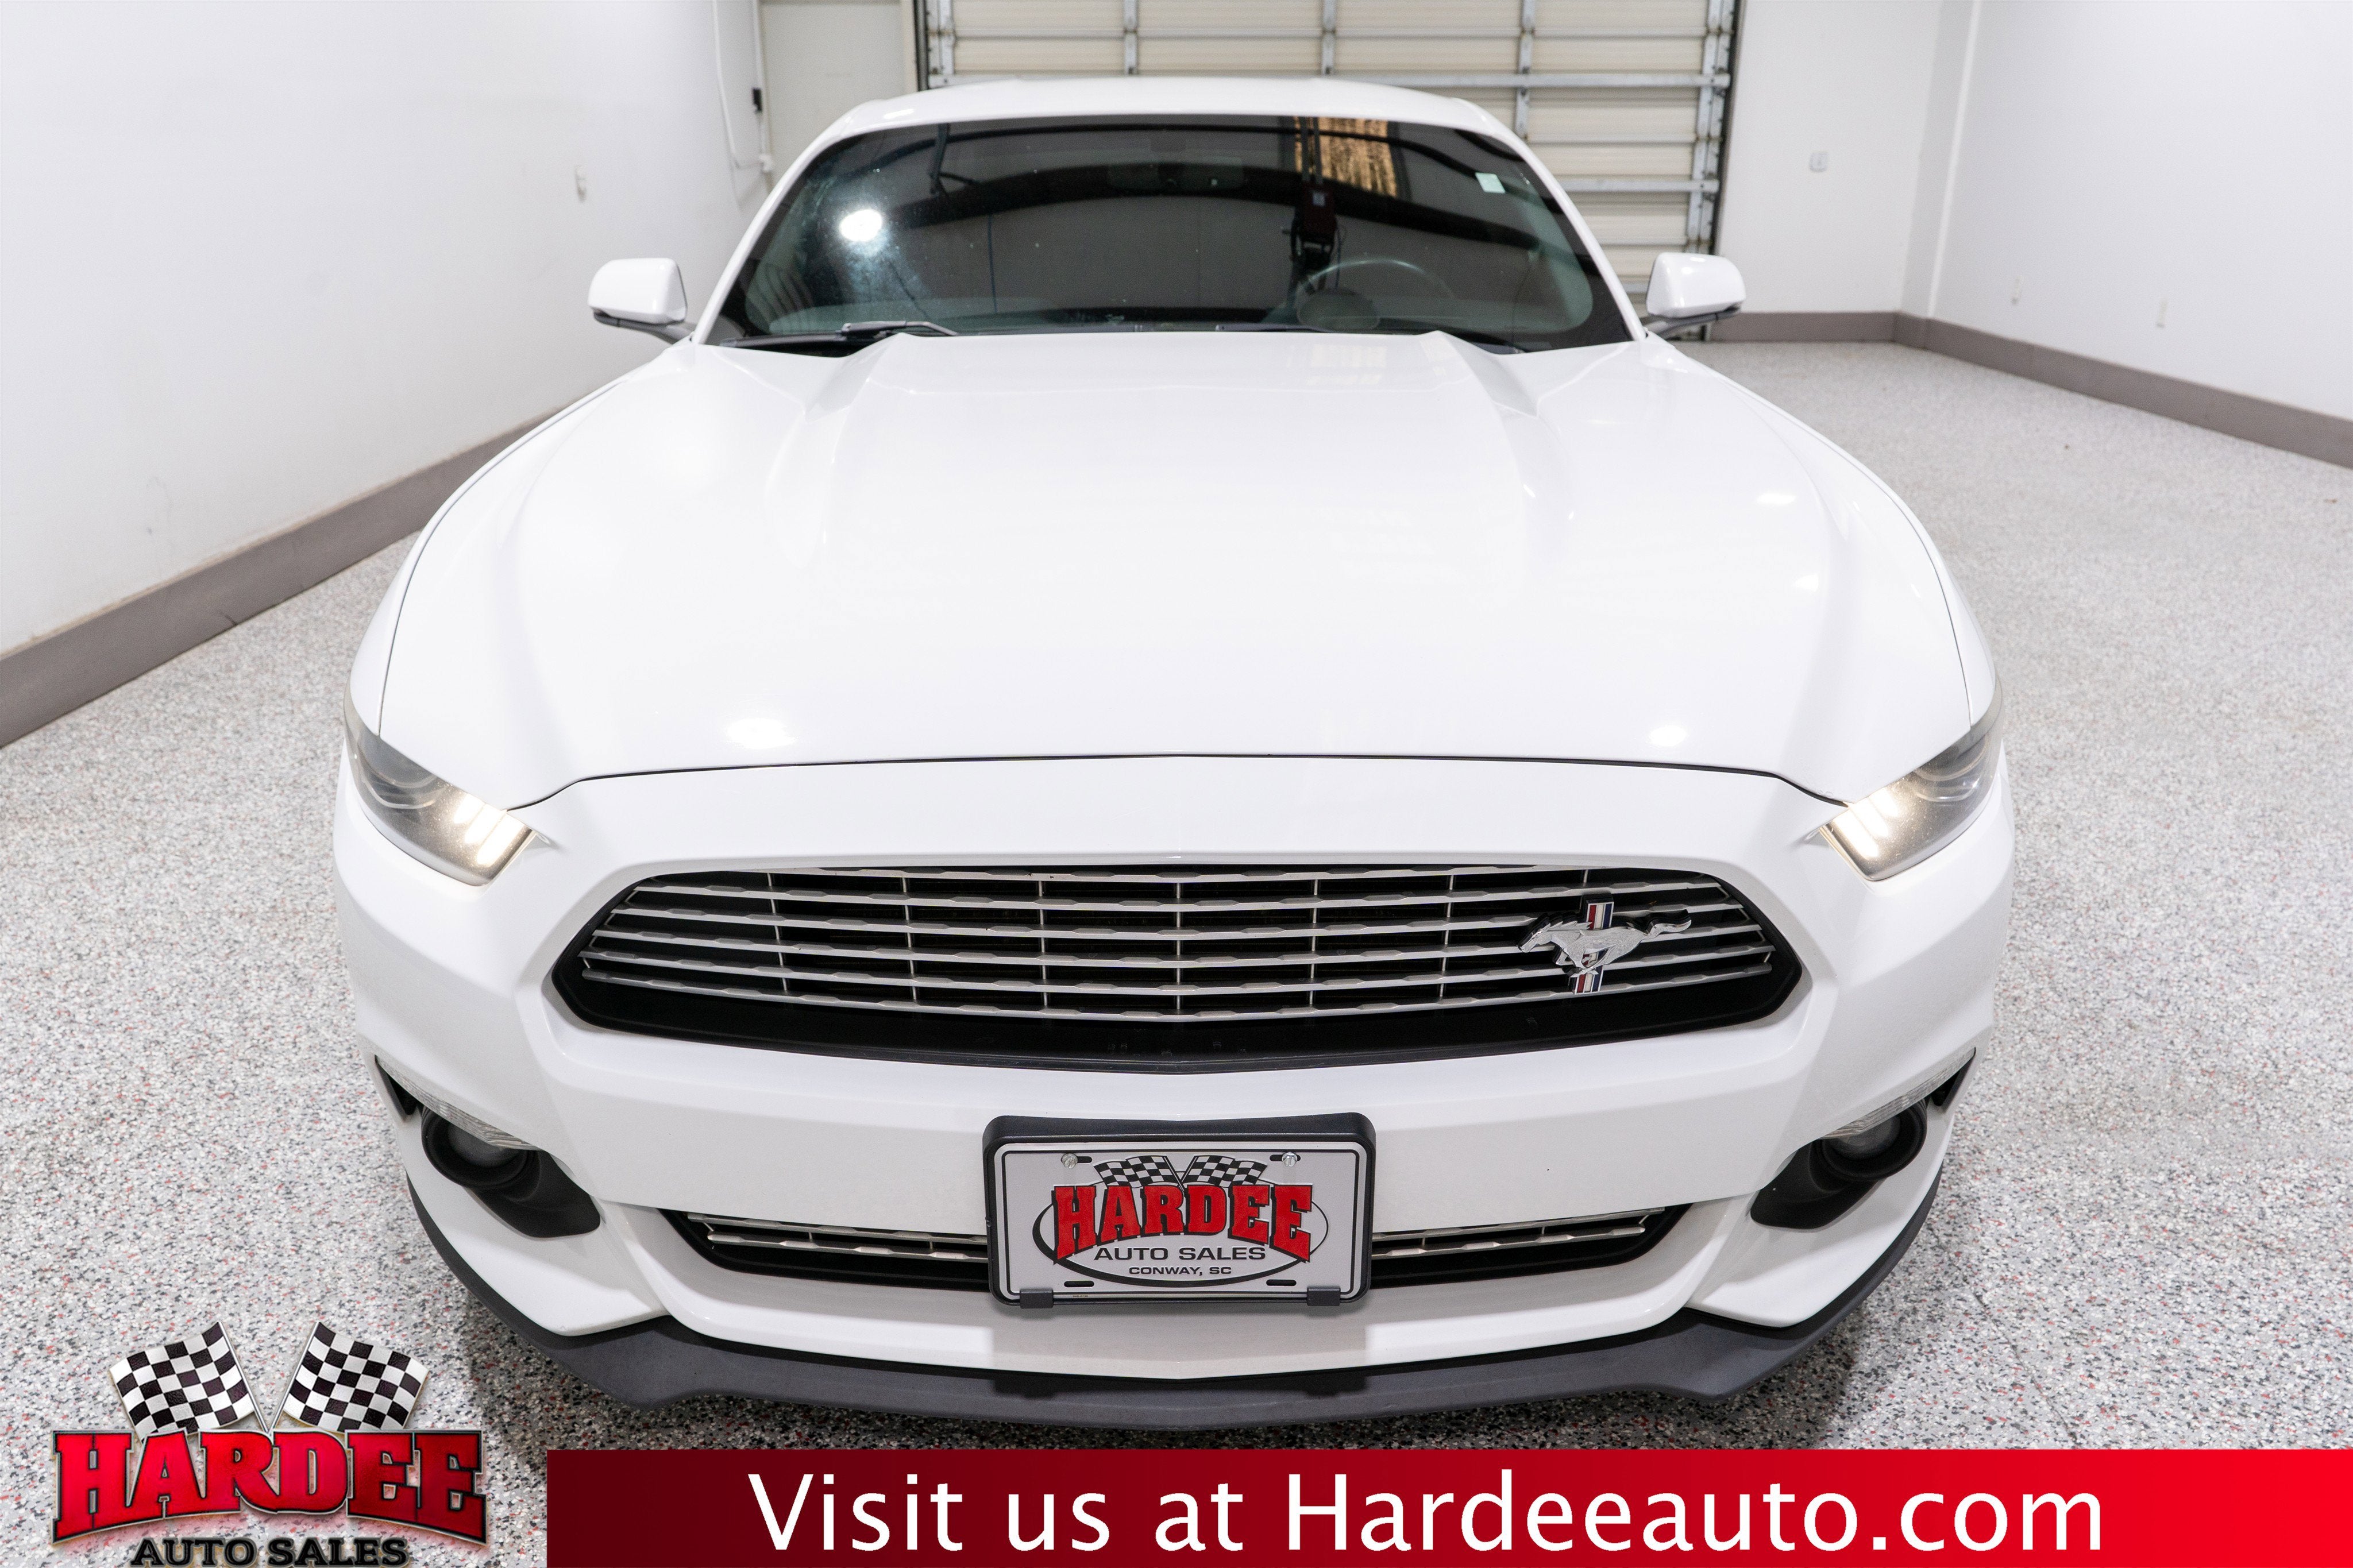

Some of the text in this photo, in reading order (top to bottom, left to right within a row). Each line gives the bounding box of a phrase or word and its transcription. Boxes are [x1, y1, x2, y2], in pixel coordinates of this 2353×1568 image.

[1051, 1185, 1313, 1264] HARDEE
[1094, 1247, 1266, 1261] AUTO SALES
[1129, 1266, 1232, 1277] CONWAY, SC
